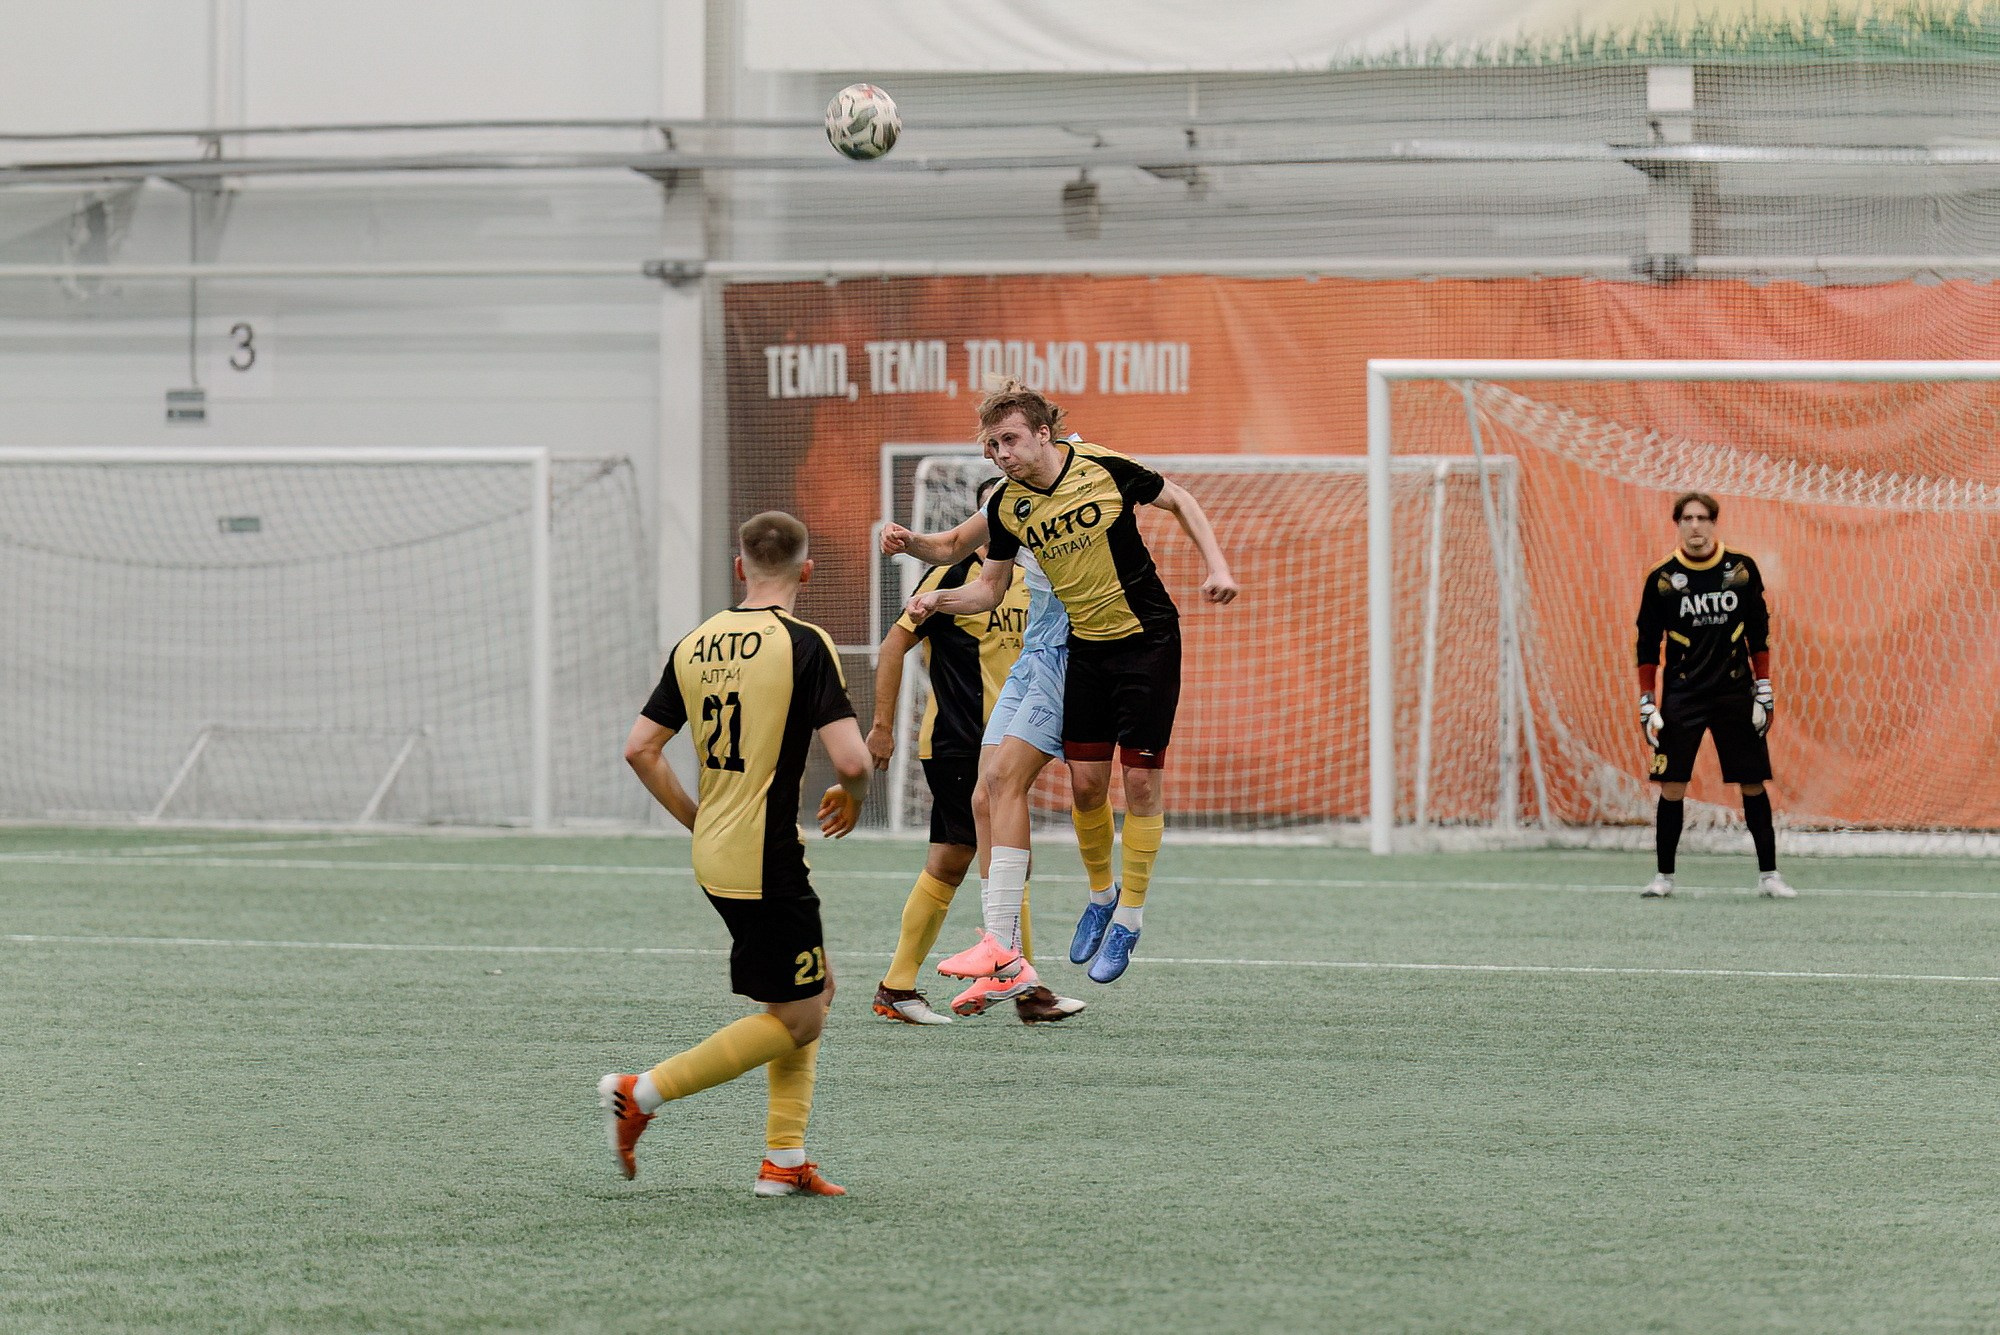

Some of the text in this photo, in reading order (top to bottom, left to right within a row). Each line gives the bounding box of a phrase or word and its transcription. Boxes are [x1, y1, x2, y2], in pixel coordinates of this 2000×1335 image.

[230, 323, 255, 371] 3
[765, 339, 1190, 400] ТЕМП, ТЕМП, ТОЛЬКО ТЕМП!
[1026, 502, 1101, 551] АКТО
[1043, 533, 1092, 560] АЛТАЙ
[986, 608, 1028, 632] АКТ
[1679, 590, 1738, 617] АКТО
[689, 632, 761, 664] АКТО
[702, 691, 745, 773] 21
[1028, 705, 1053, 728] 17
[794, 946, 825, 986] 21
